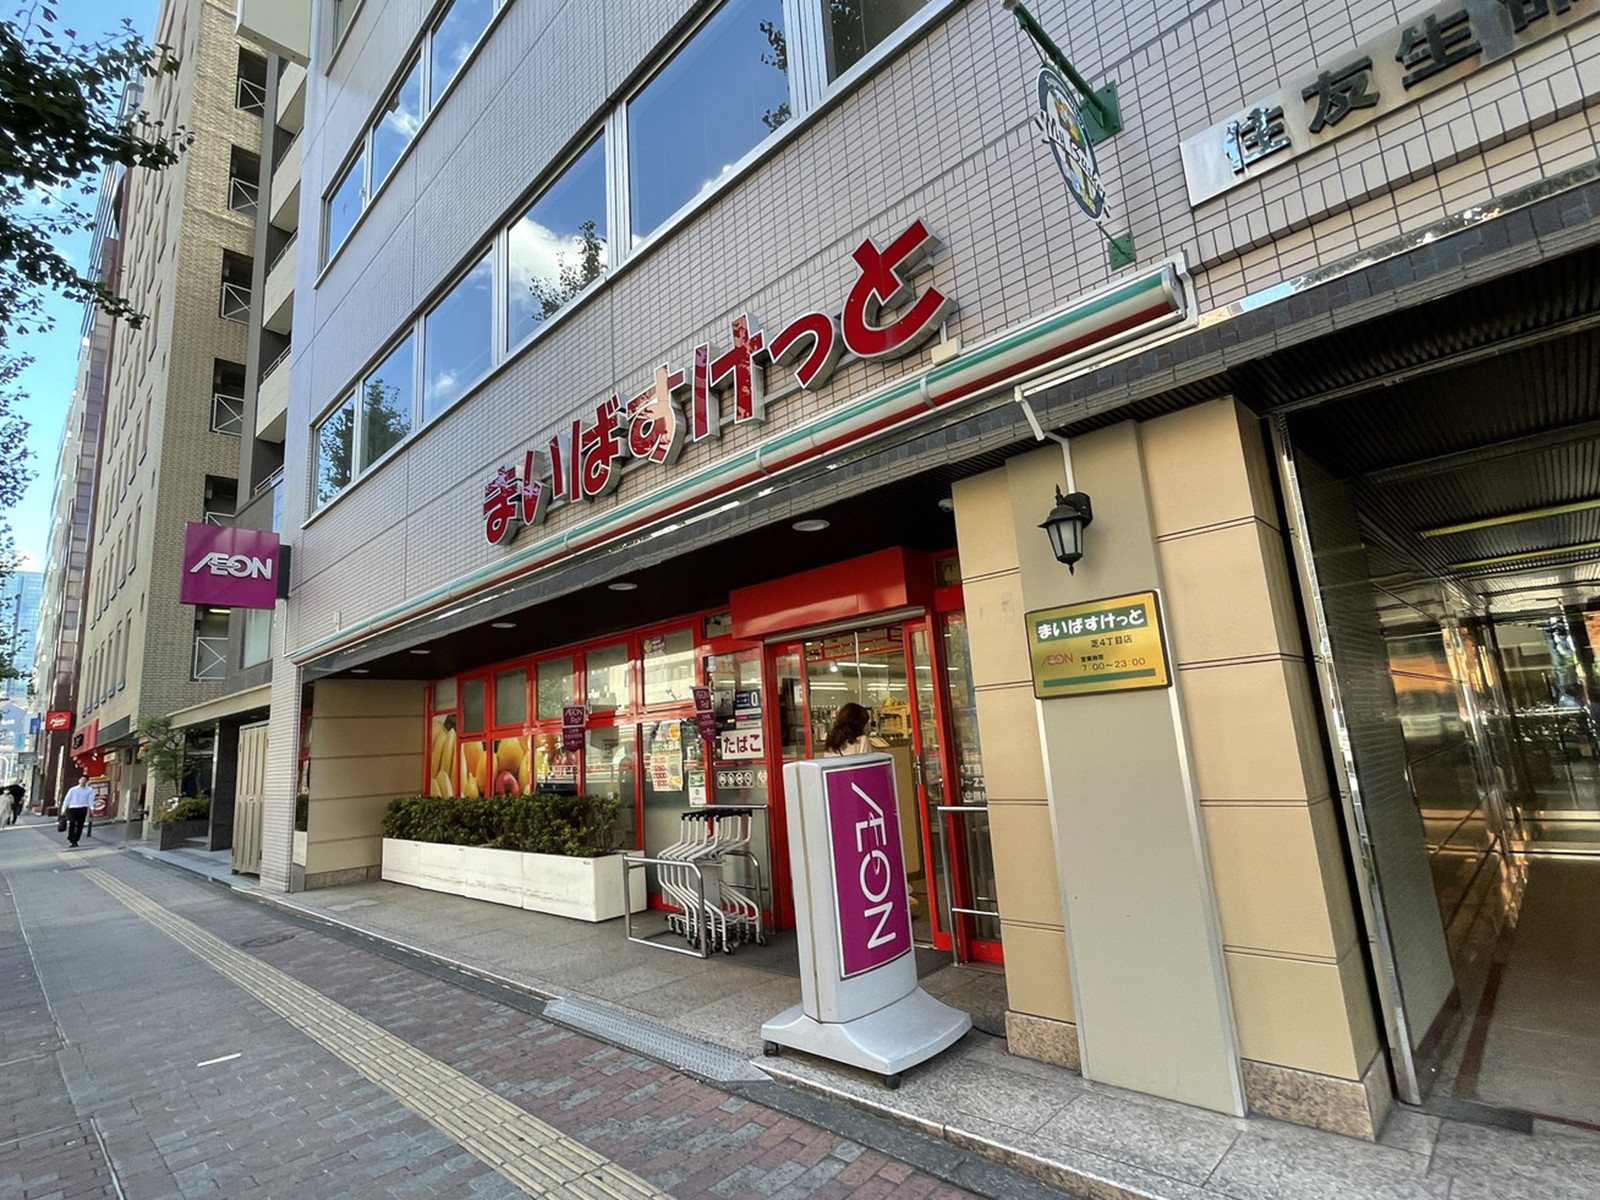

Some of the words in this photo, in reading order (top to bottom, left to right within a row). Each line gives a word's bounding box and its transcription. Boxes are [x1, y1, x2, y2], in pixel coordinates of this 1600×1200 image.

[483, 216, 953, 546] まいばすけっと
[190, 552, 272, 579] AEON
[1037, 608, 1144, 640] まいばすけっと
[1091, 634, 1133, 648] 芝4丁目店
[1041, 653, 1074, 667] AEON
[723, 734, 762, 753] たばこ
[851, 782, 896, 949] AEON
